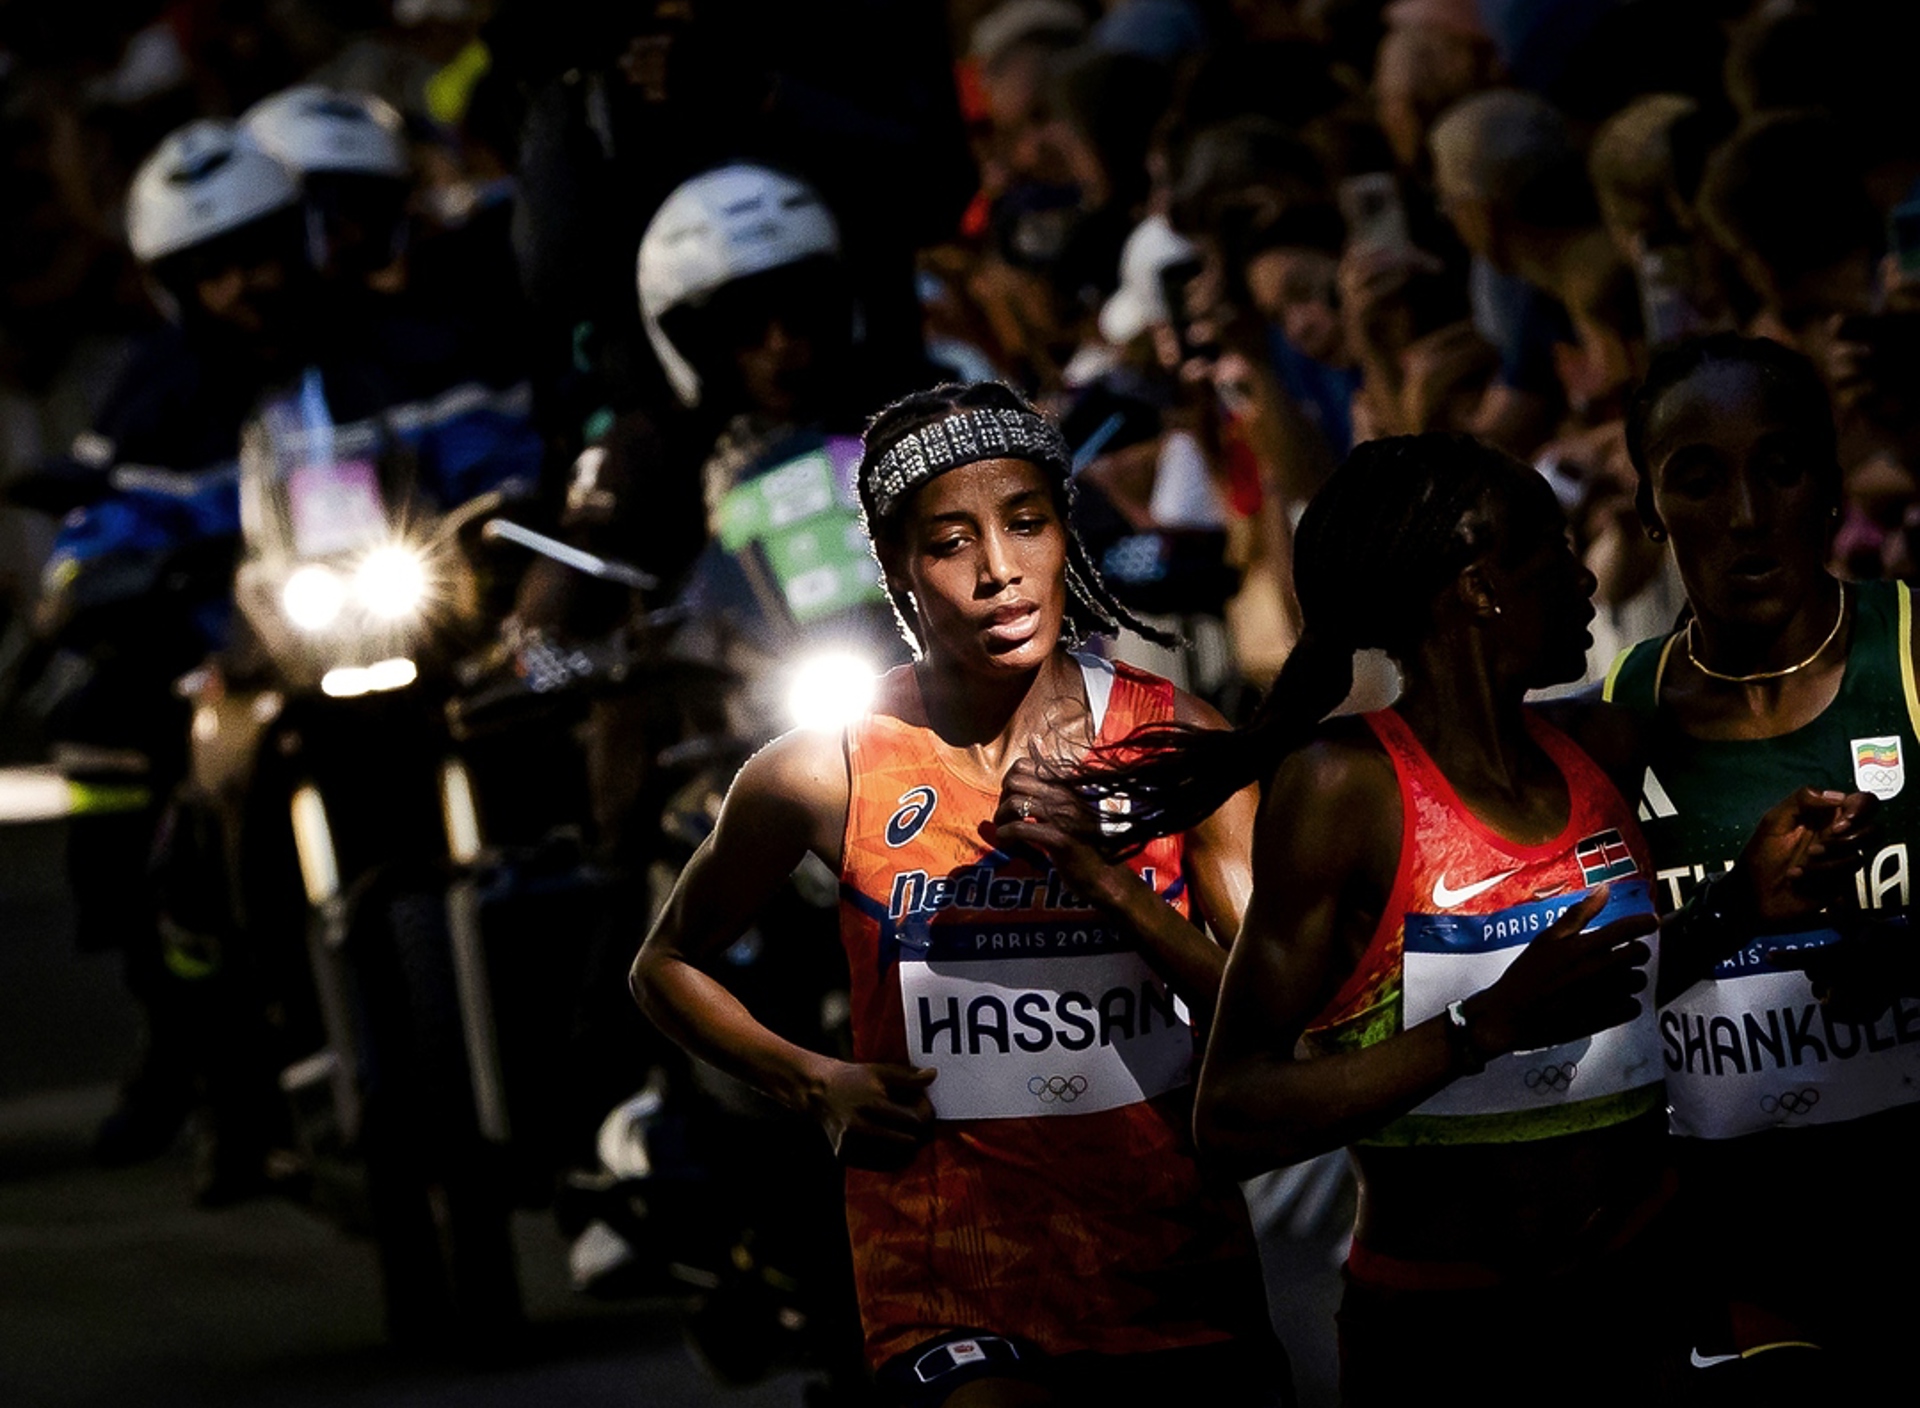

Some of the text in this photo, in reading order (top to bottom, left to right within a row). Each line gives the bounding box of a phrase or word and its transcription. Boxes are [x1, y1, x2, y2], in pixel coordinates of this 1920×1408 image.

[975, 928, 1120, 950] PARIS 2024
[1482, 913, 1539, 941] PARIS
[918, 980, 1175, 1054] HASSAN
